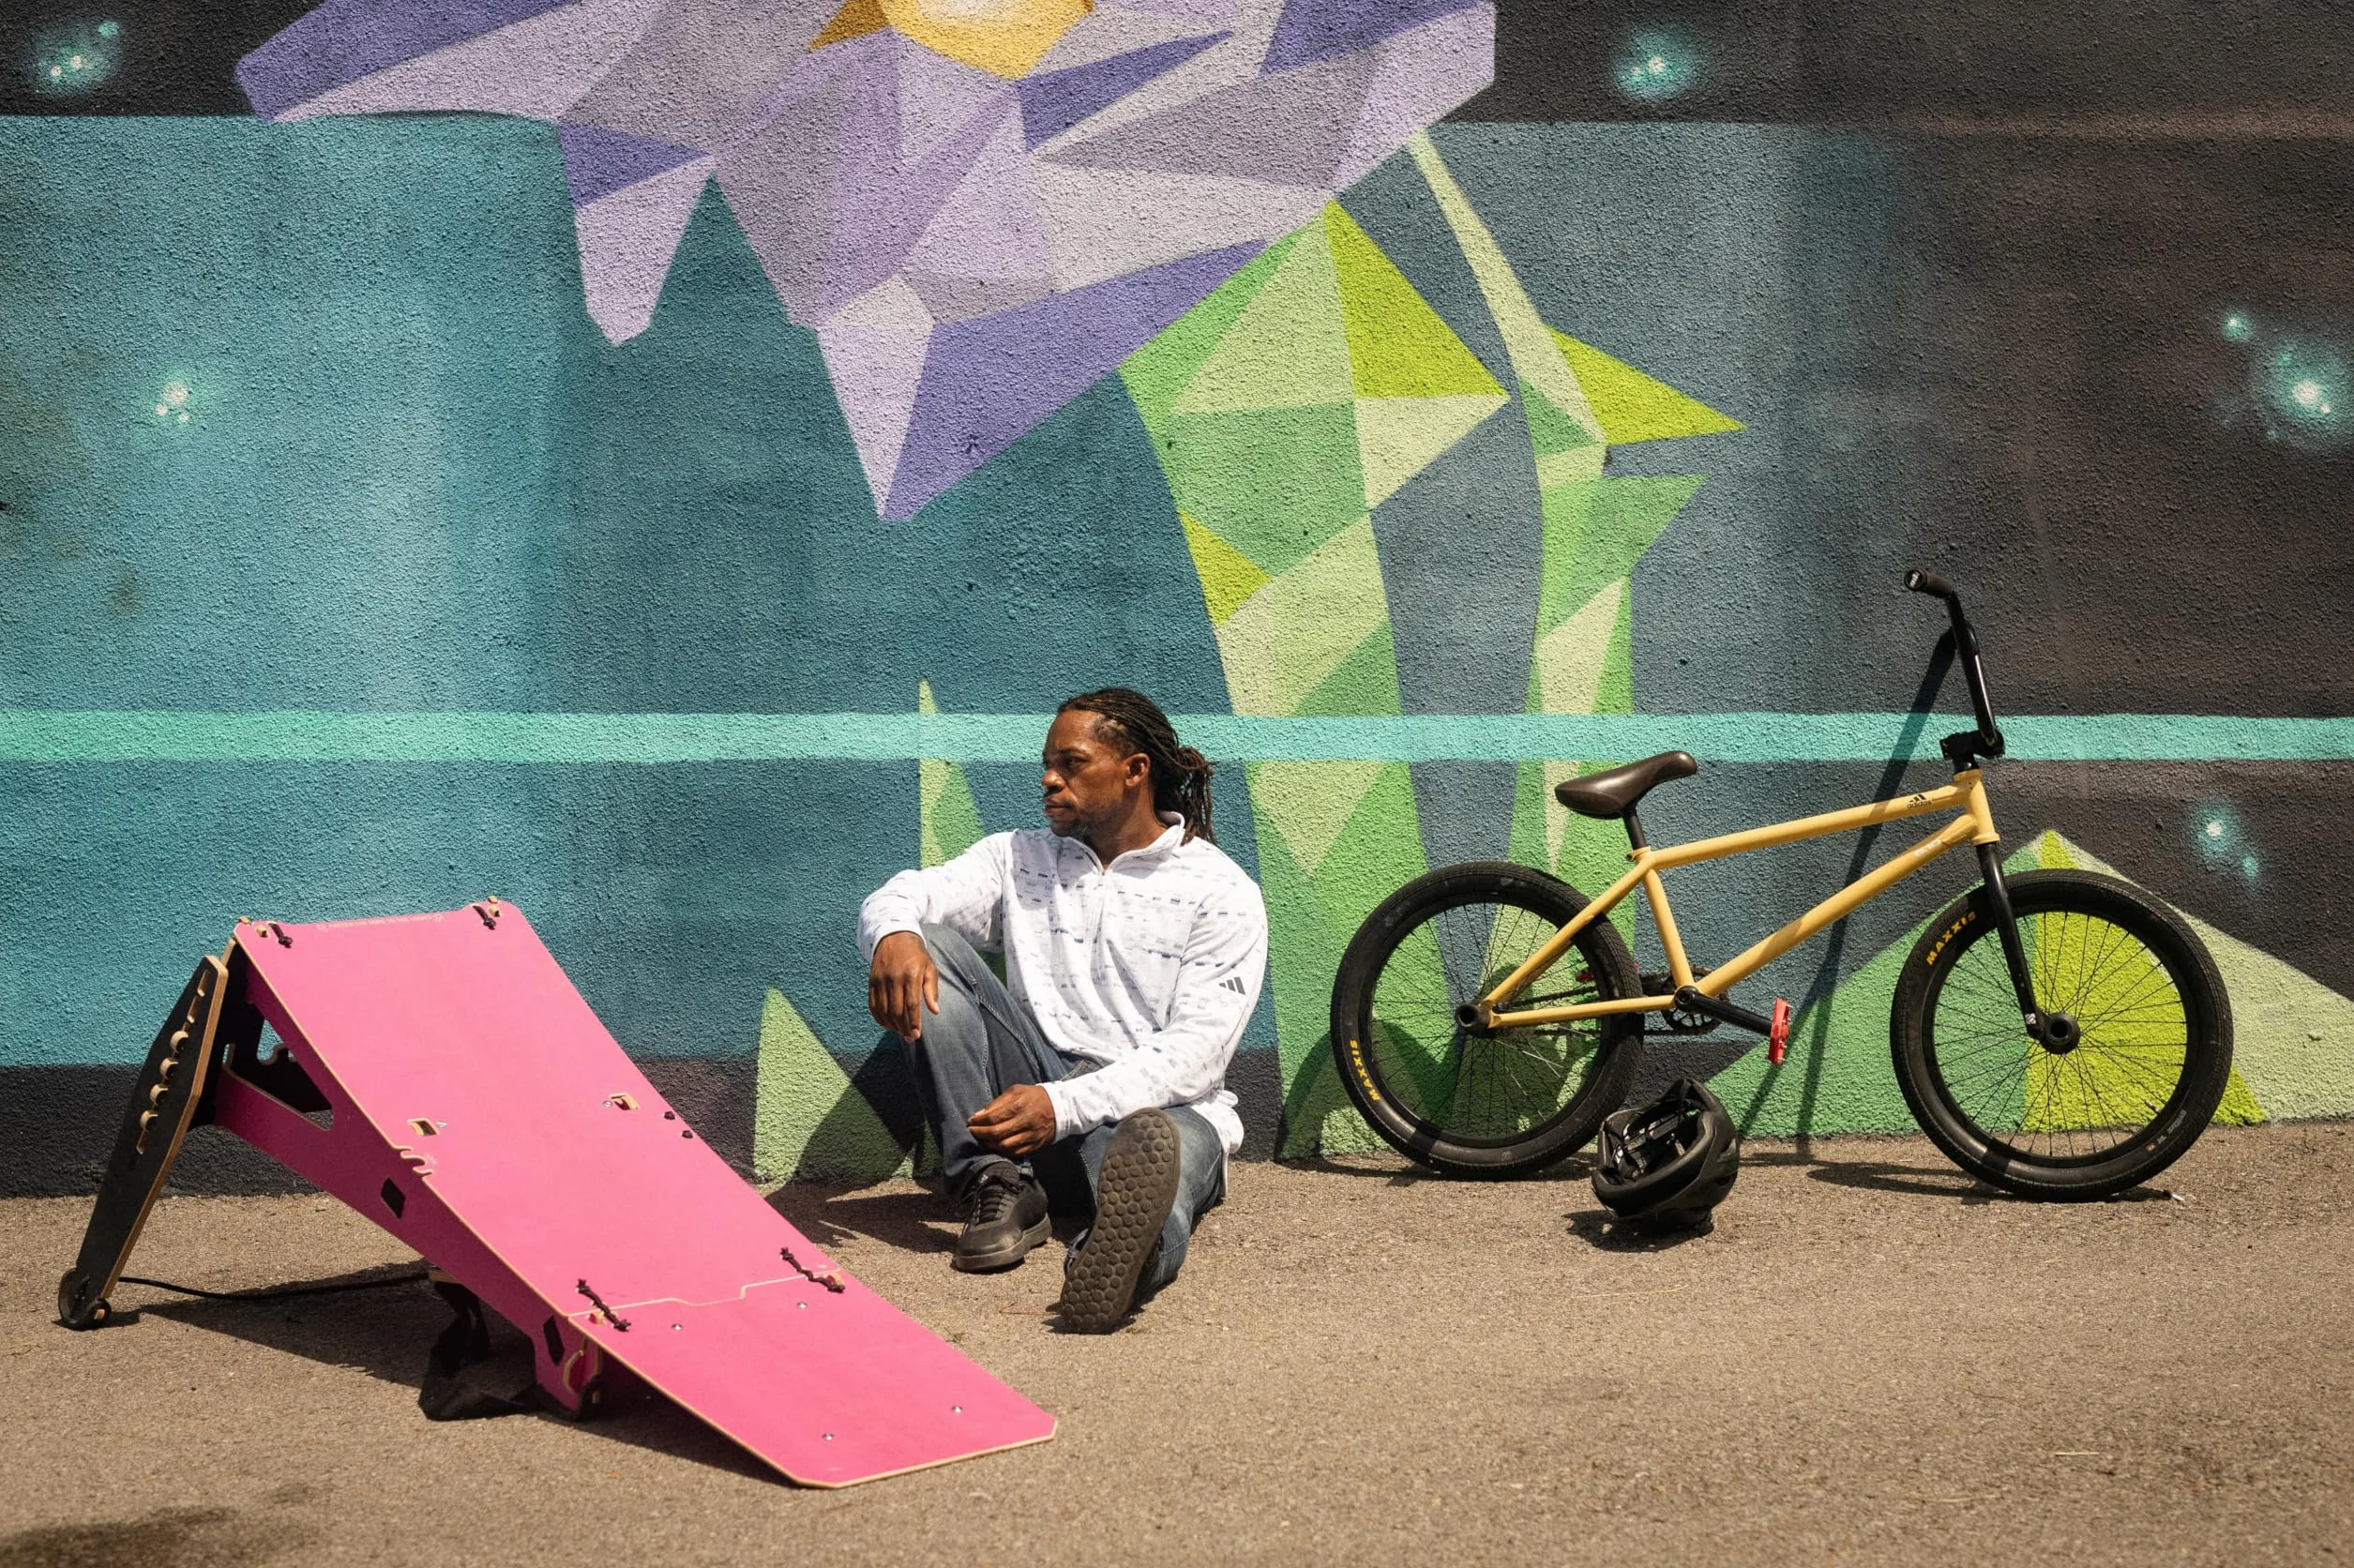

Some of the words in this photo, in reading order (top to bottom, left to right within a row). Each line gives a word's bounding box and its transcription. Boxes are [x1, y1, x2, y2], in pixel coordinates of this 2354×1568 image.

[1907, 800, 1932, 809] adidas
[1926, 912, 1976, 966] MAXXIS
[1350, 1040, 1381, 1101] MAXXIS
